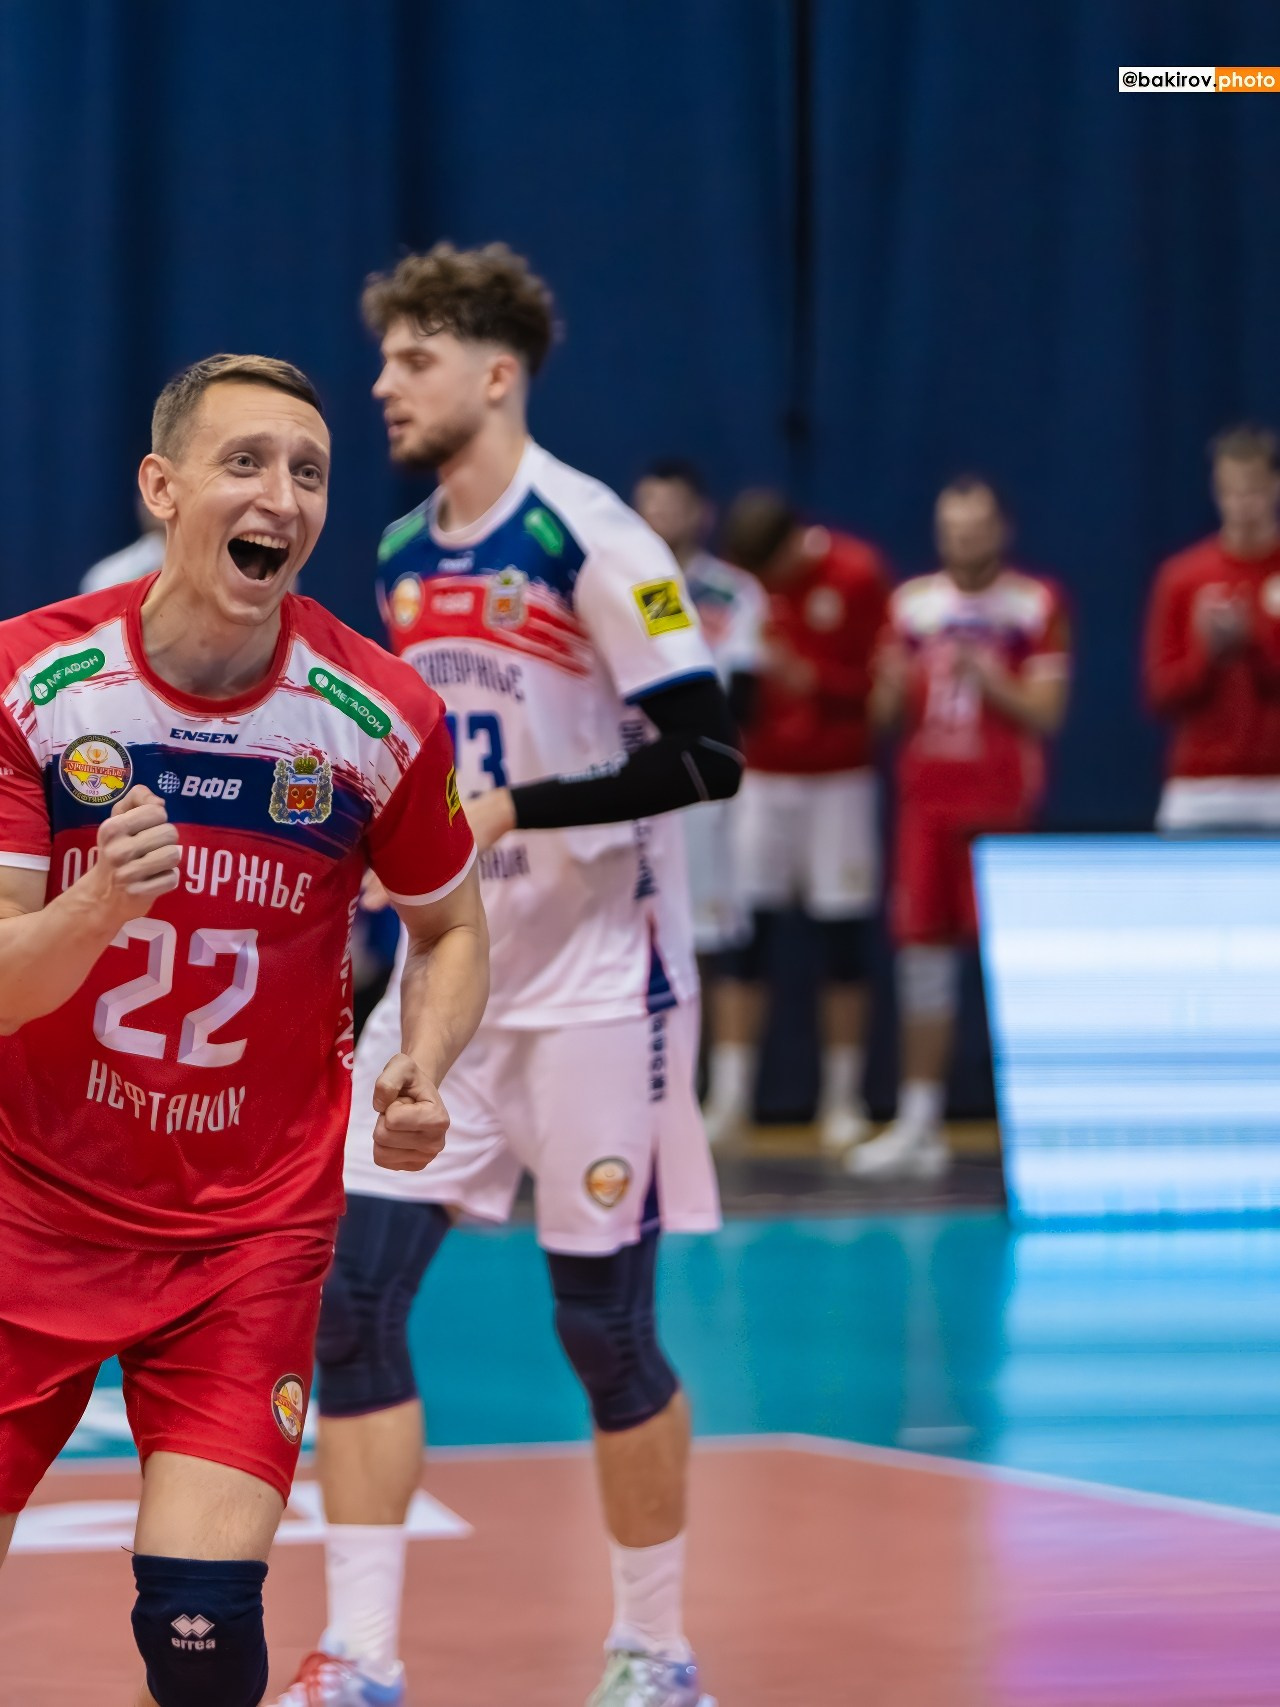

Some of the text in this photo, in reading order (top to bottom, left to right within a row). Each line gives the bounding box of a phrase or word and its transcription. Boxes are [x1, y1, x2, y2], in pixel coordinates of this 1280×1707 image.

[328, 683, 385, 732] МЕГАФОН
[169, 727, 239, 745] ENSEN
[181, 775, 243, 800] ВФВ
[93, 916, 260, 1068] 22
[86, 1059, 246, 1135] НЕФТЯНИК
[170, 1637, 216, 1650] errea
